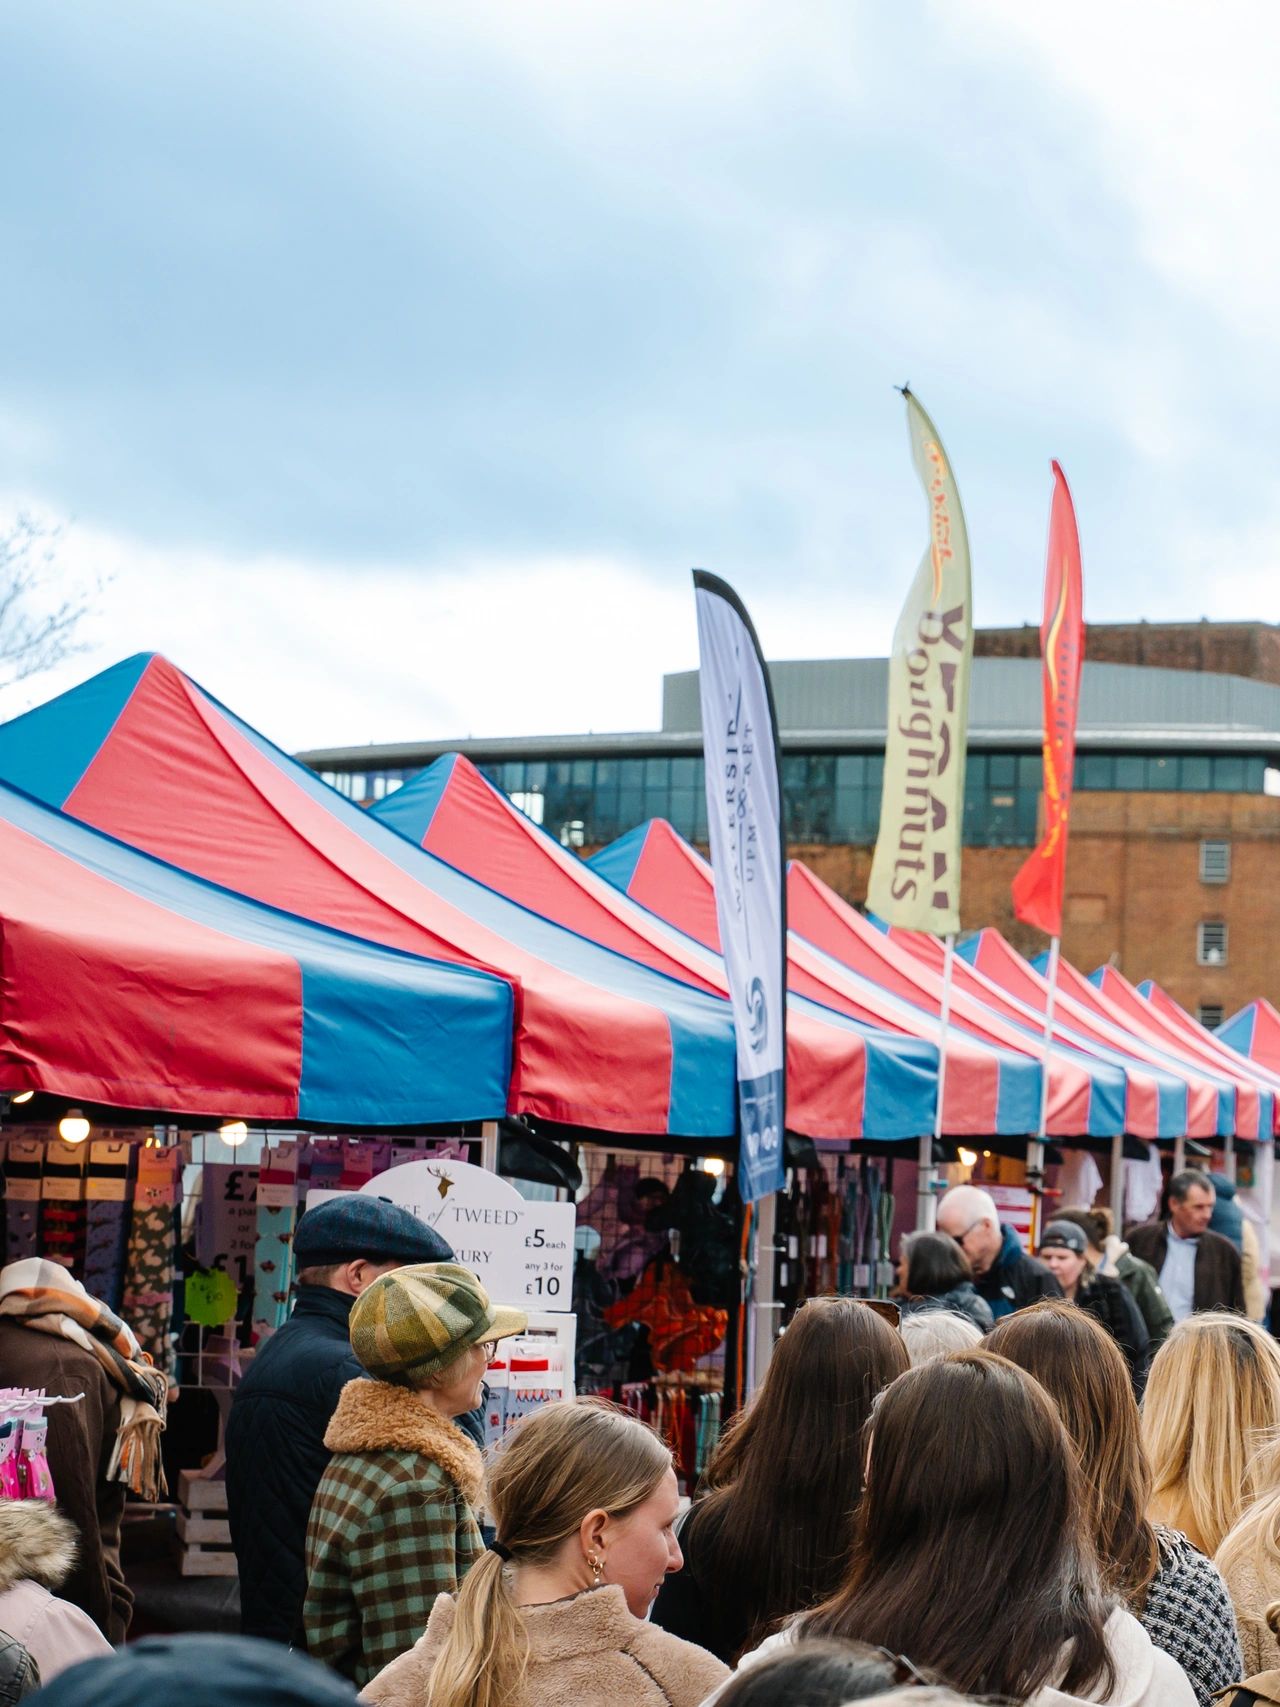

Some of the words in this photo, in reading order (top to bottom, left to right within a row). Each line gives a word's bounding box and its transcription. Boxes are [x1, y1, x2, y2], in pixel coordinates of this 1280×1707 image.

[453, 1250, 493, 1263] XURY
[525, 1263, 540, 1272] any
[543, 1262, 549, 1271] 3
[550, 1262, 563, 1271] for
[526, 1276, 560, 1296] £10
